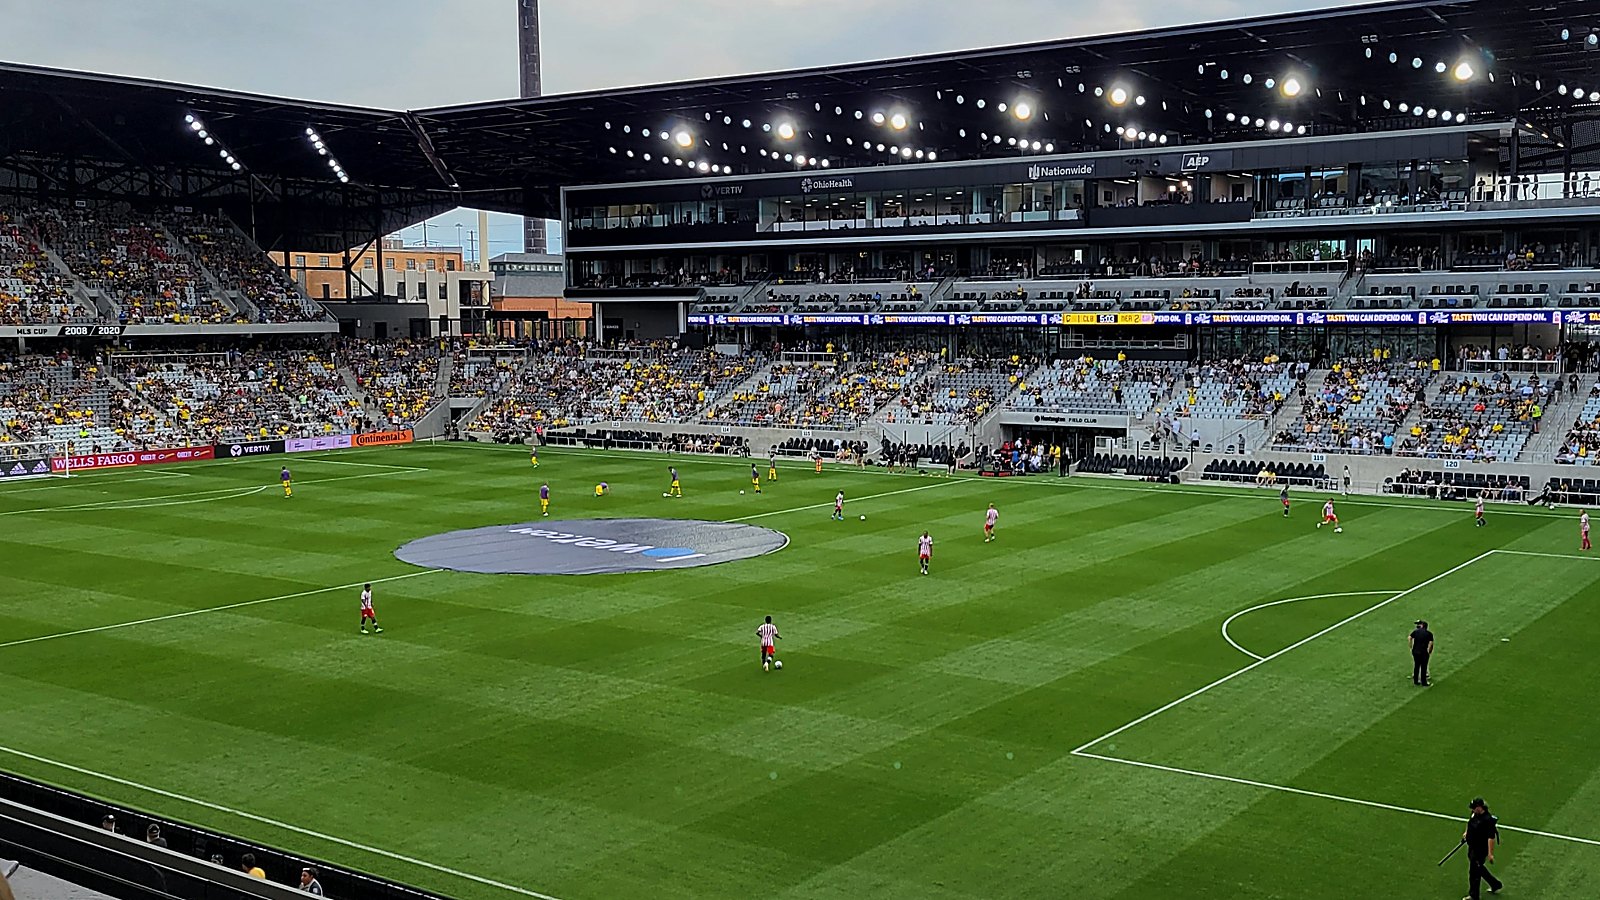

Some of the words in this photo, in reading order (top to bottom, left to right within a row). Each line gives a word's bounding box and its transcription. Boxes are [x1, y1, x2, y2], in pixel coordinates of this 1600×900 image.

[1186, 156, 1210, 167] AEP
[1041, 165, 1092, 176] Nationwide
[813, 179, 853, 189] OhioHealth
[714, 186, 743, 195] VERTIV
[1503, 313, 1532, 321] DEPEND
[65, 327, 88, 335] 2008
[98, 327, 120, 335] 2020
[356, 433, 400, 446] Continental
[244, 445, 270, 453] VERTIV
[54, 457, 94, 469] WELLS
[98, 454, 135, 466] FARGO
